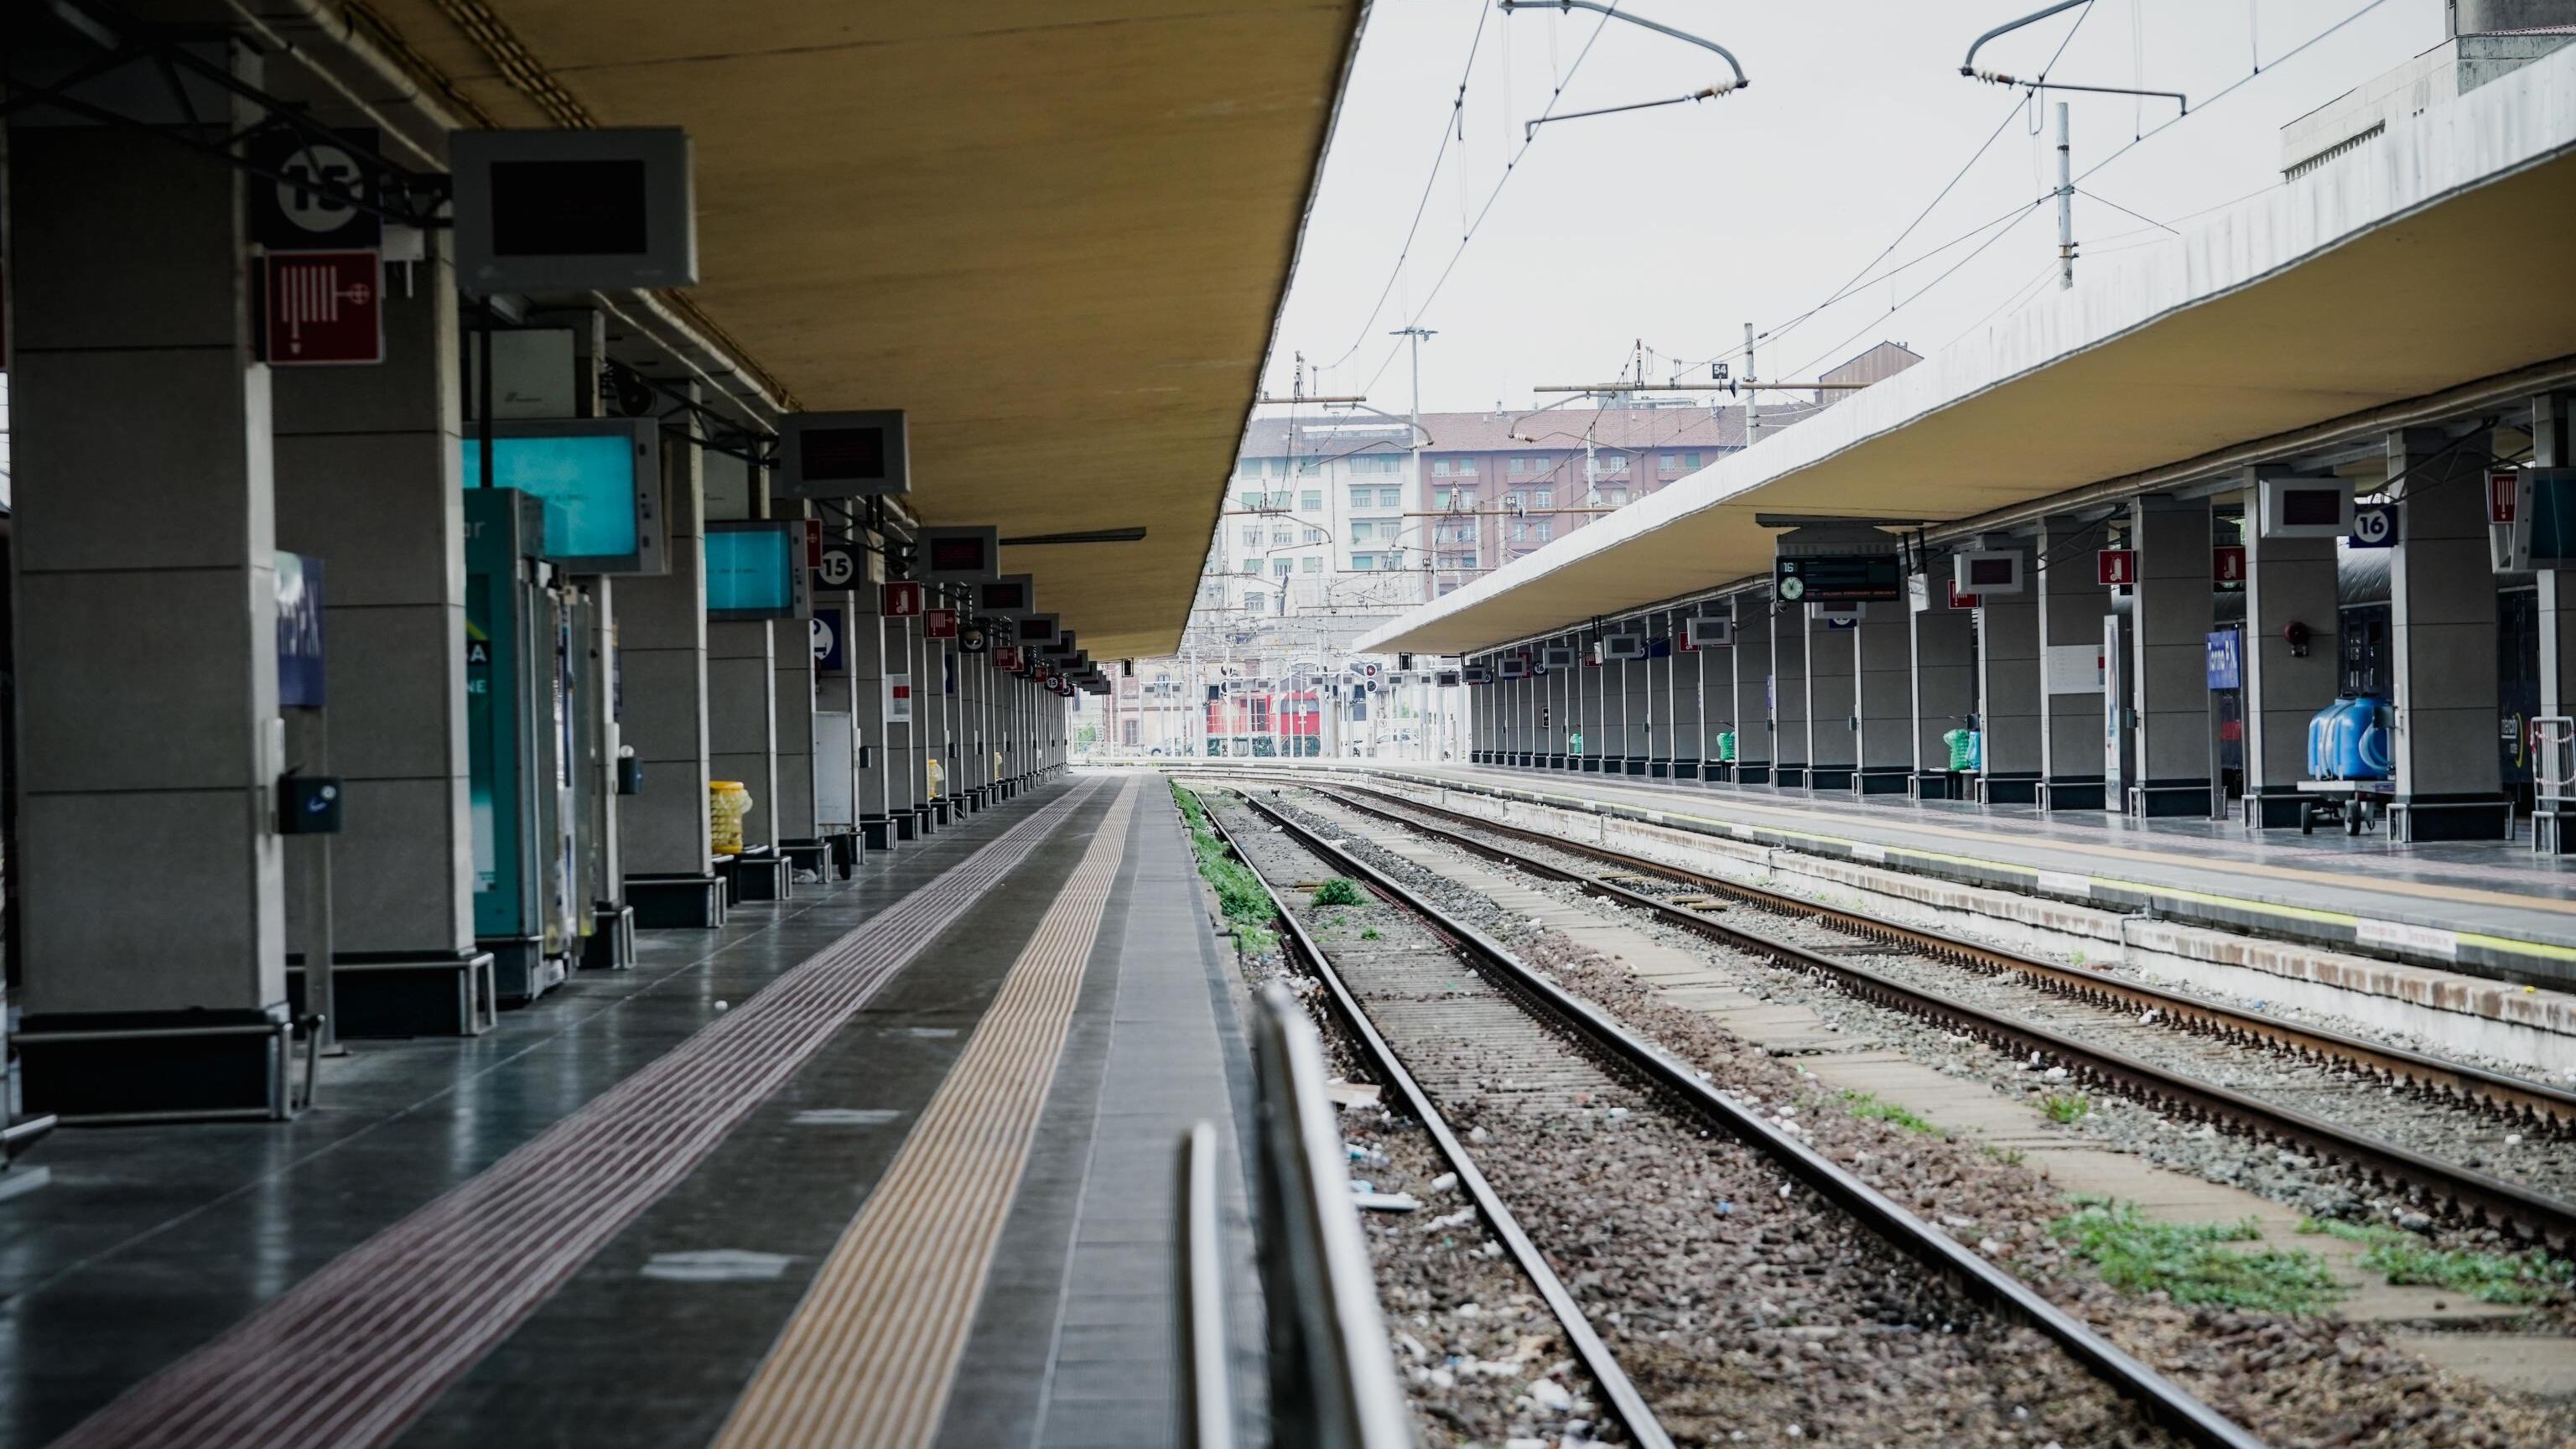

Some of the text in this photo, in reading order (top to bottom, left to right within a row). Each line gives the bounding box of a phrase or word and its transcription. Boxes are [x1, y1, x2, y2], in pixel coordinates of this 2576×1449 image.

[288, 164, 350, 210] 15
[1714, 365, 1727, 375] 54
[2360, 516, 2384, 535] 16
[823, 558, 848, 577] 15
[1783, 562, 1794, 573] 16
